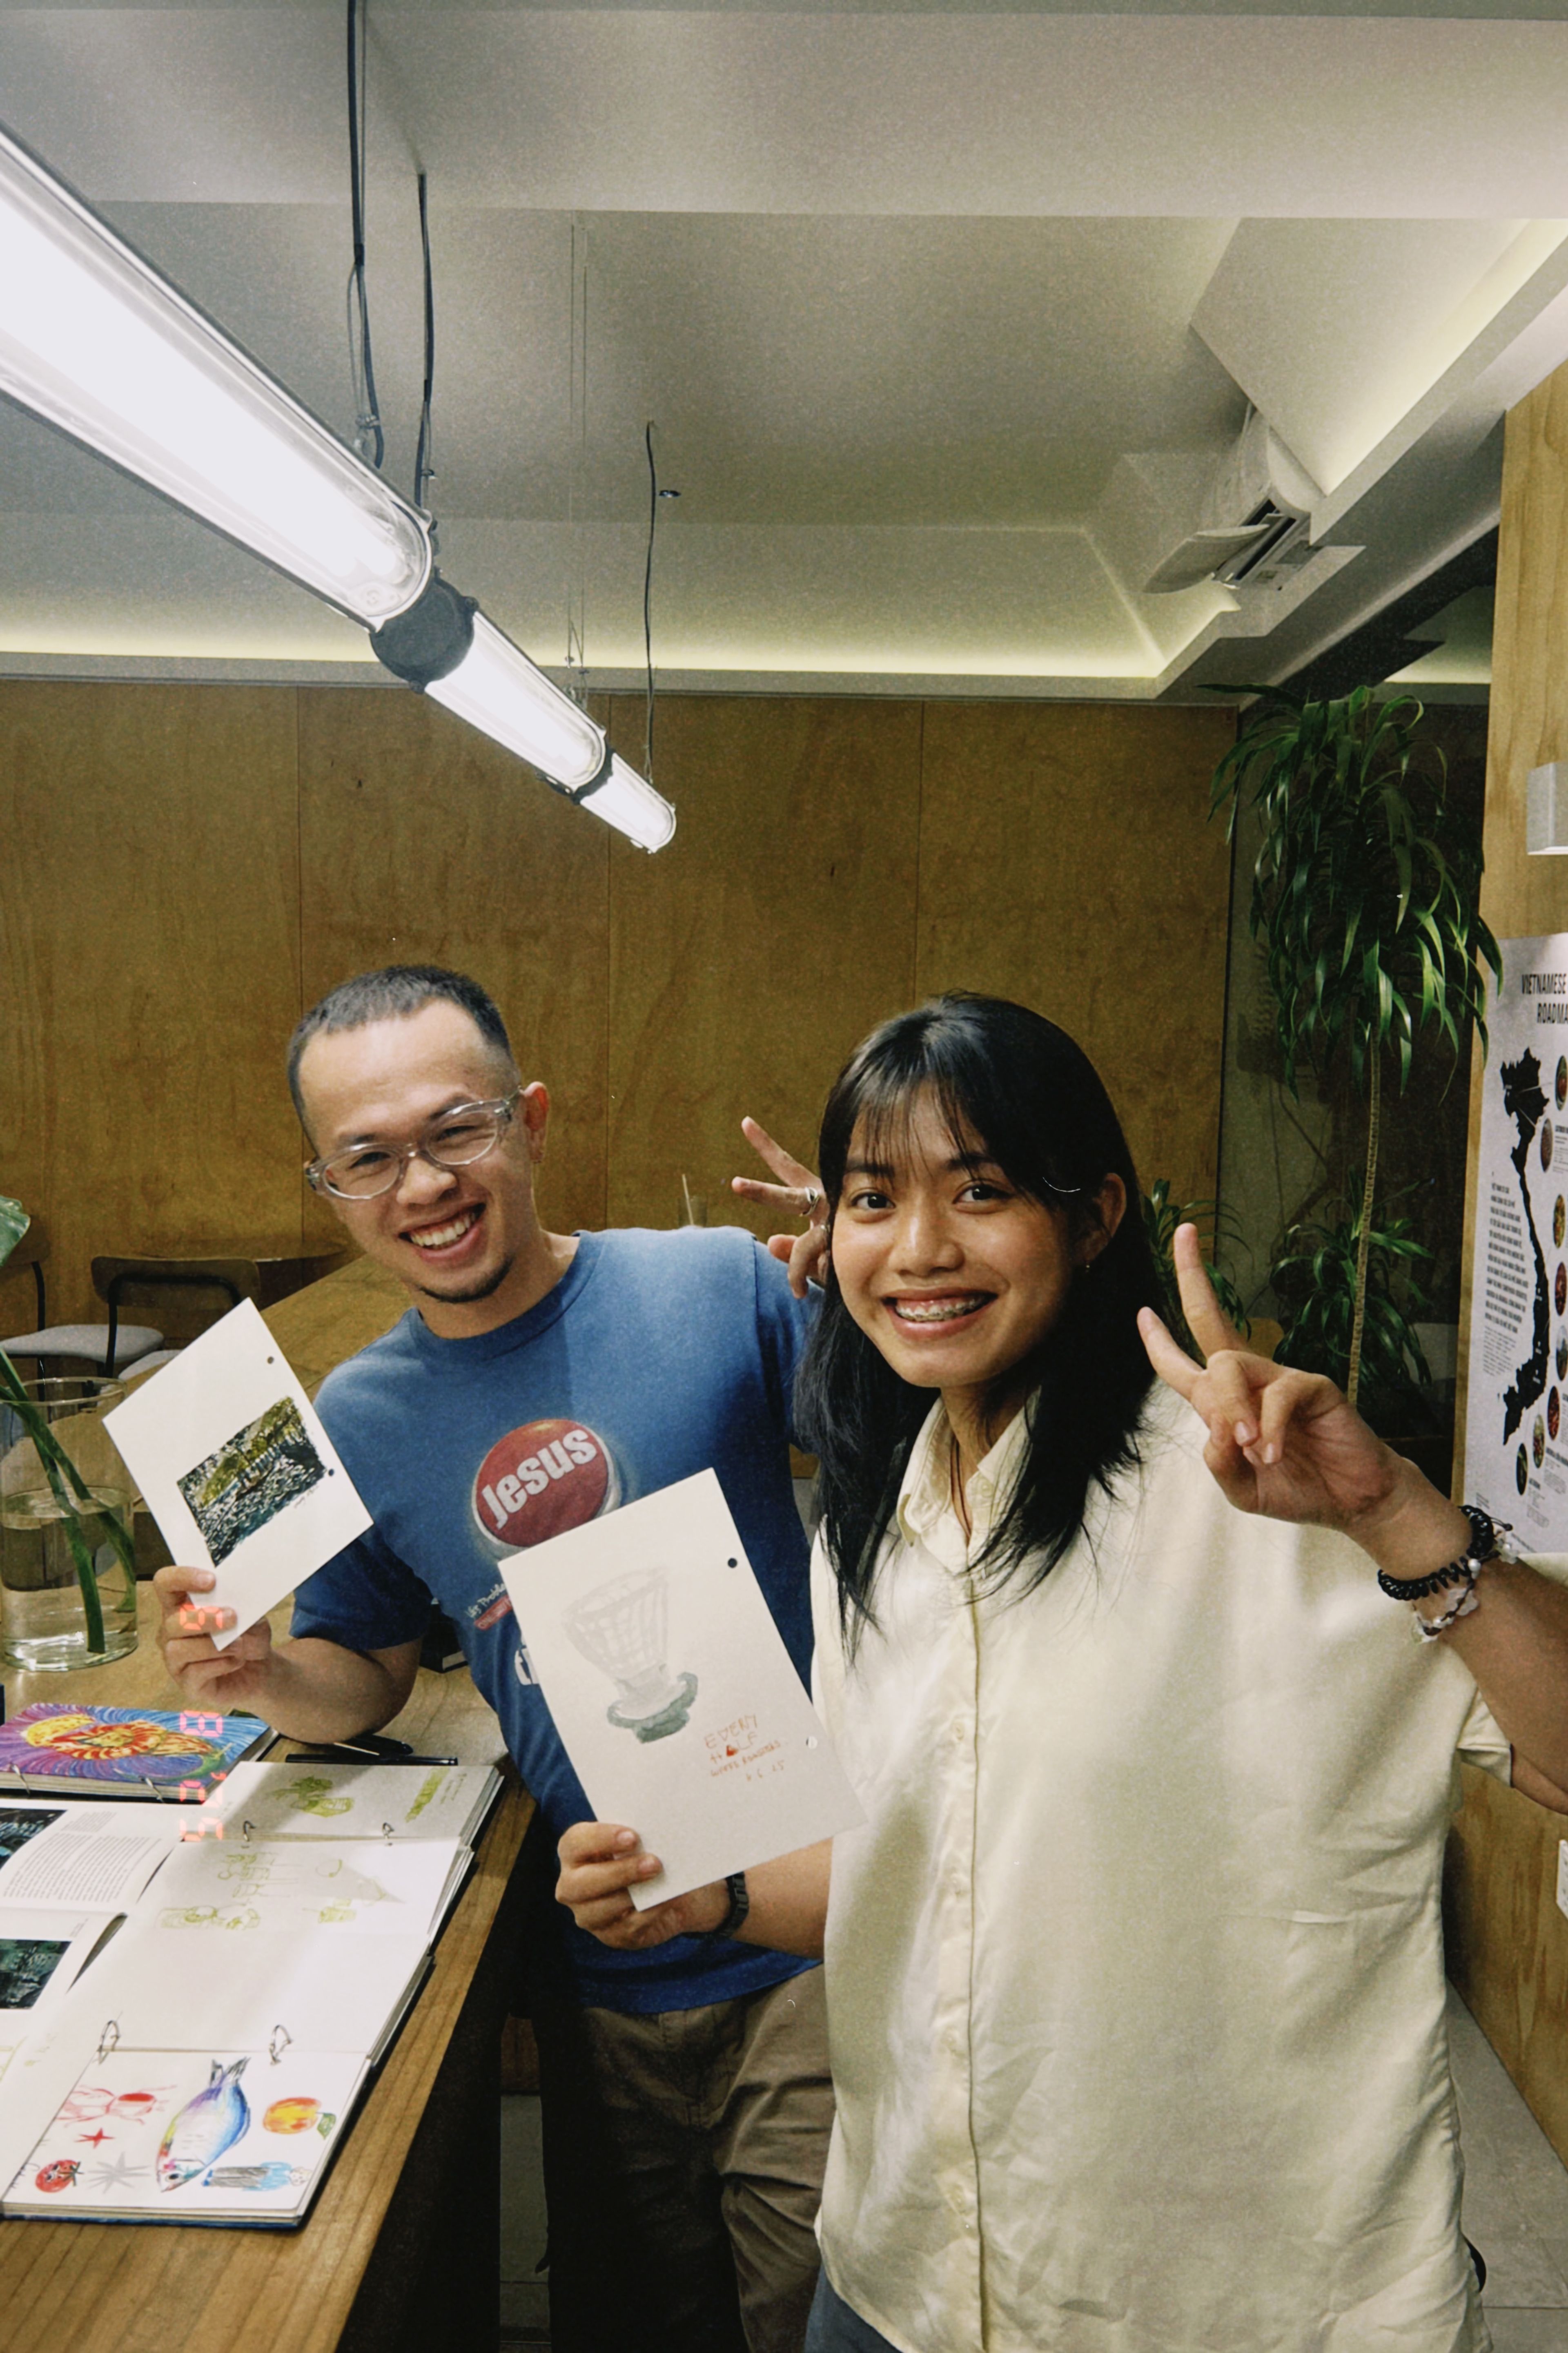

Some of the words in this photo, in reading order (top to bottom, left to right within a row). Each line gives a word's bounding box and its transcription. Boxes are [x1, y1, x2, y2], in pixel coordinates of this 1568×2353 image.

[1521, 973, 1566, 994] VIETNAMESE
[1537, 1002, 1568, 1024] ROADMA
[481, 1429, 597, 1530] Jesus
